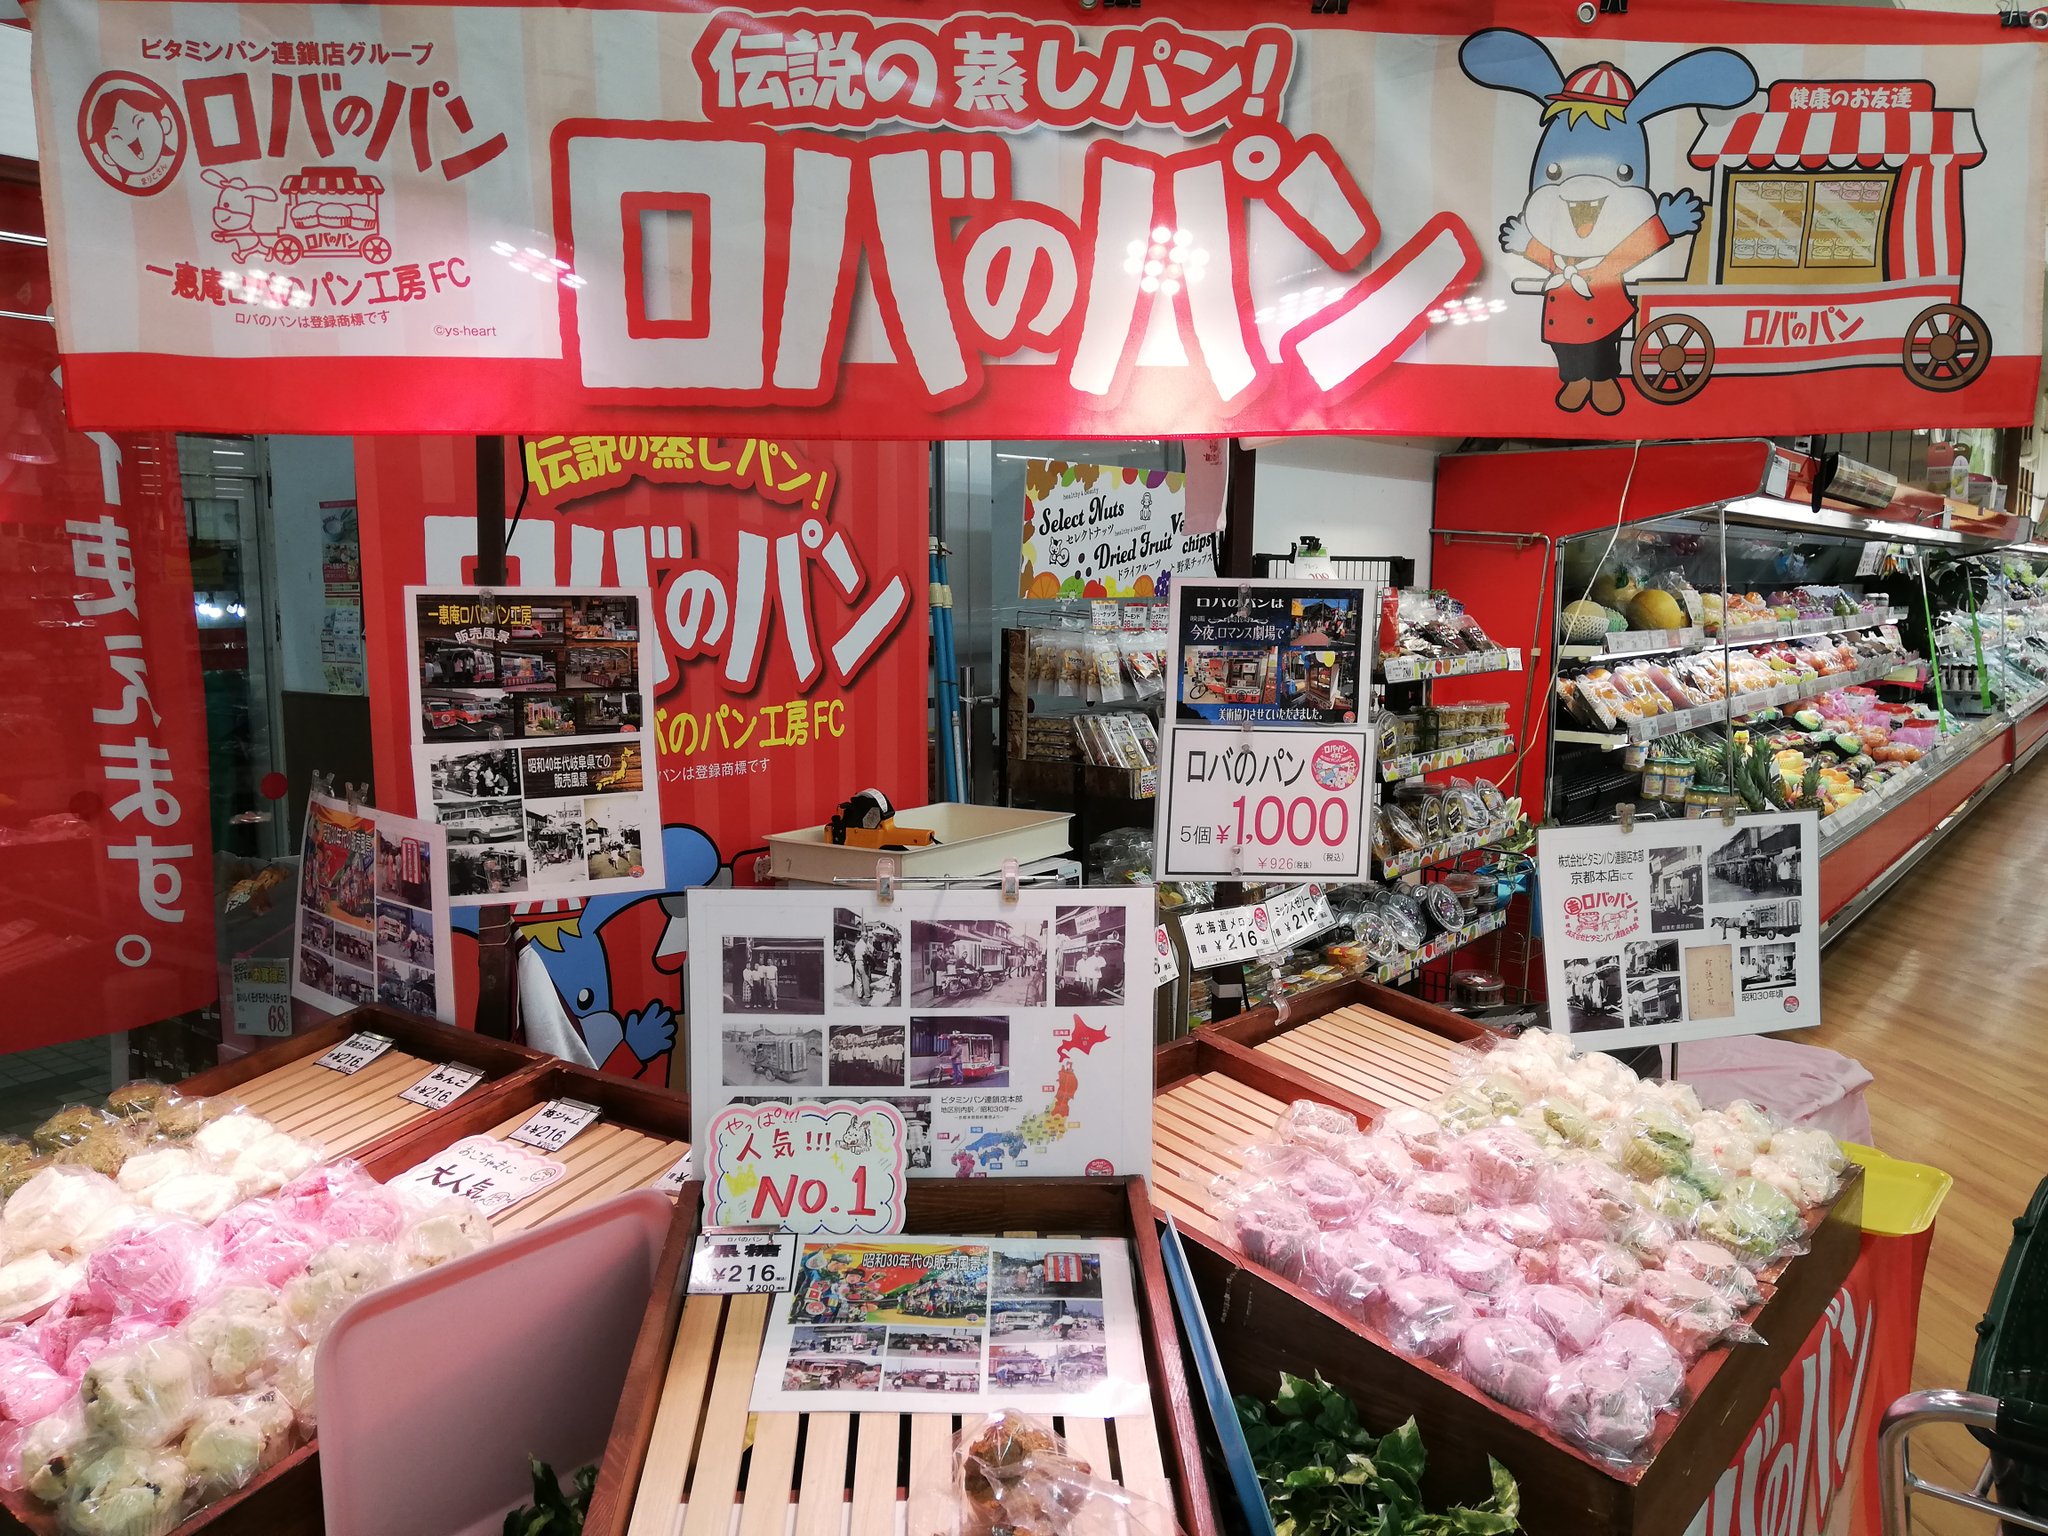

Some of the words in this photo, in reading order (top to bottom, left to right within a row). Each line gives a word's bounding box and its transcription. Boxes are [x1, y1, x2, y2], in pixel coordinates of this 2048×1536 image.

[141, 37, 434, 67] ビタミンパン連鎖店グループ
[1789, 86, 1913, 111] 健康のお友達
[182, 73, 509, 182] ロバのパン
[306, 232, 360, 250] ロバのパン
[567, 134, 1469, 402] ロバのパン
[234, 310, 390, 329] ロバのパンは登録商標です
[1743, 305, 1864, 346] ロバのパン
[1038, 507, 1084, 535] Select
[1089, 495, 1124, 525] Nuts
[1066, 524, 1114, 544] セレクトナッツ
[1182, 532, 1213, 554] chips
[1094, 540, 1136, 570] Dried
[1140, 531, 1173, 557] Fruit
[1117, 558, 1162, 582] ドライフルーツ
[1176, 554, 1213, 574] 野菜チップス
[455, 627, 510, 645] 販売風景
[1190, 624, 1285, 641] 今夜、ロマンス劇場で
[1218, 708, 1323, 721] 美術協力させていただきました。
[654, 699, 846, 756] のパン工房FC
[528, 754, 611, 773] 昭和40年代岐阜県での
[1187, 746, 1306, 787] ロバのパン
[554, 772, 589, 789] 販売風景
[1180, 825, 1212, 845] 5個
[1216, 795, 1349, 847] ¥1,000
[1323, 852, 1345, 863] (税込)
[1570, 869, 1634, 885] 京都本店にて
[1582, 892, 1638, 910] ロバのパン
[1194, 917, 1255, 935] 北海道メロン
[1214, 930, 1258, 952] ¥216
[1742, 990, 1784, 1003] 昭和30年頃
[268, 1004, 286, 1032] 68
[431, 1073, 469, 1088] あんこ
[941, 1095, 1023, 1104] ビタミンパン連鎖店本部
[416, 1162, 492, 1202] 大人気
[751, 1165, 876, 1219] NO.1
[862, 1252, 982, 1272] 昭和30年代の販売風景
[713, 1265, 775, 1282] ¥216
[1683, 1288, 1872, 1536] バのパン
